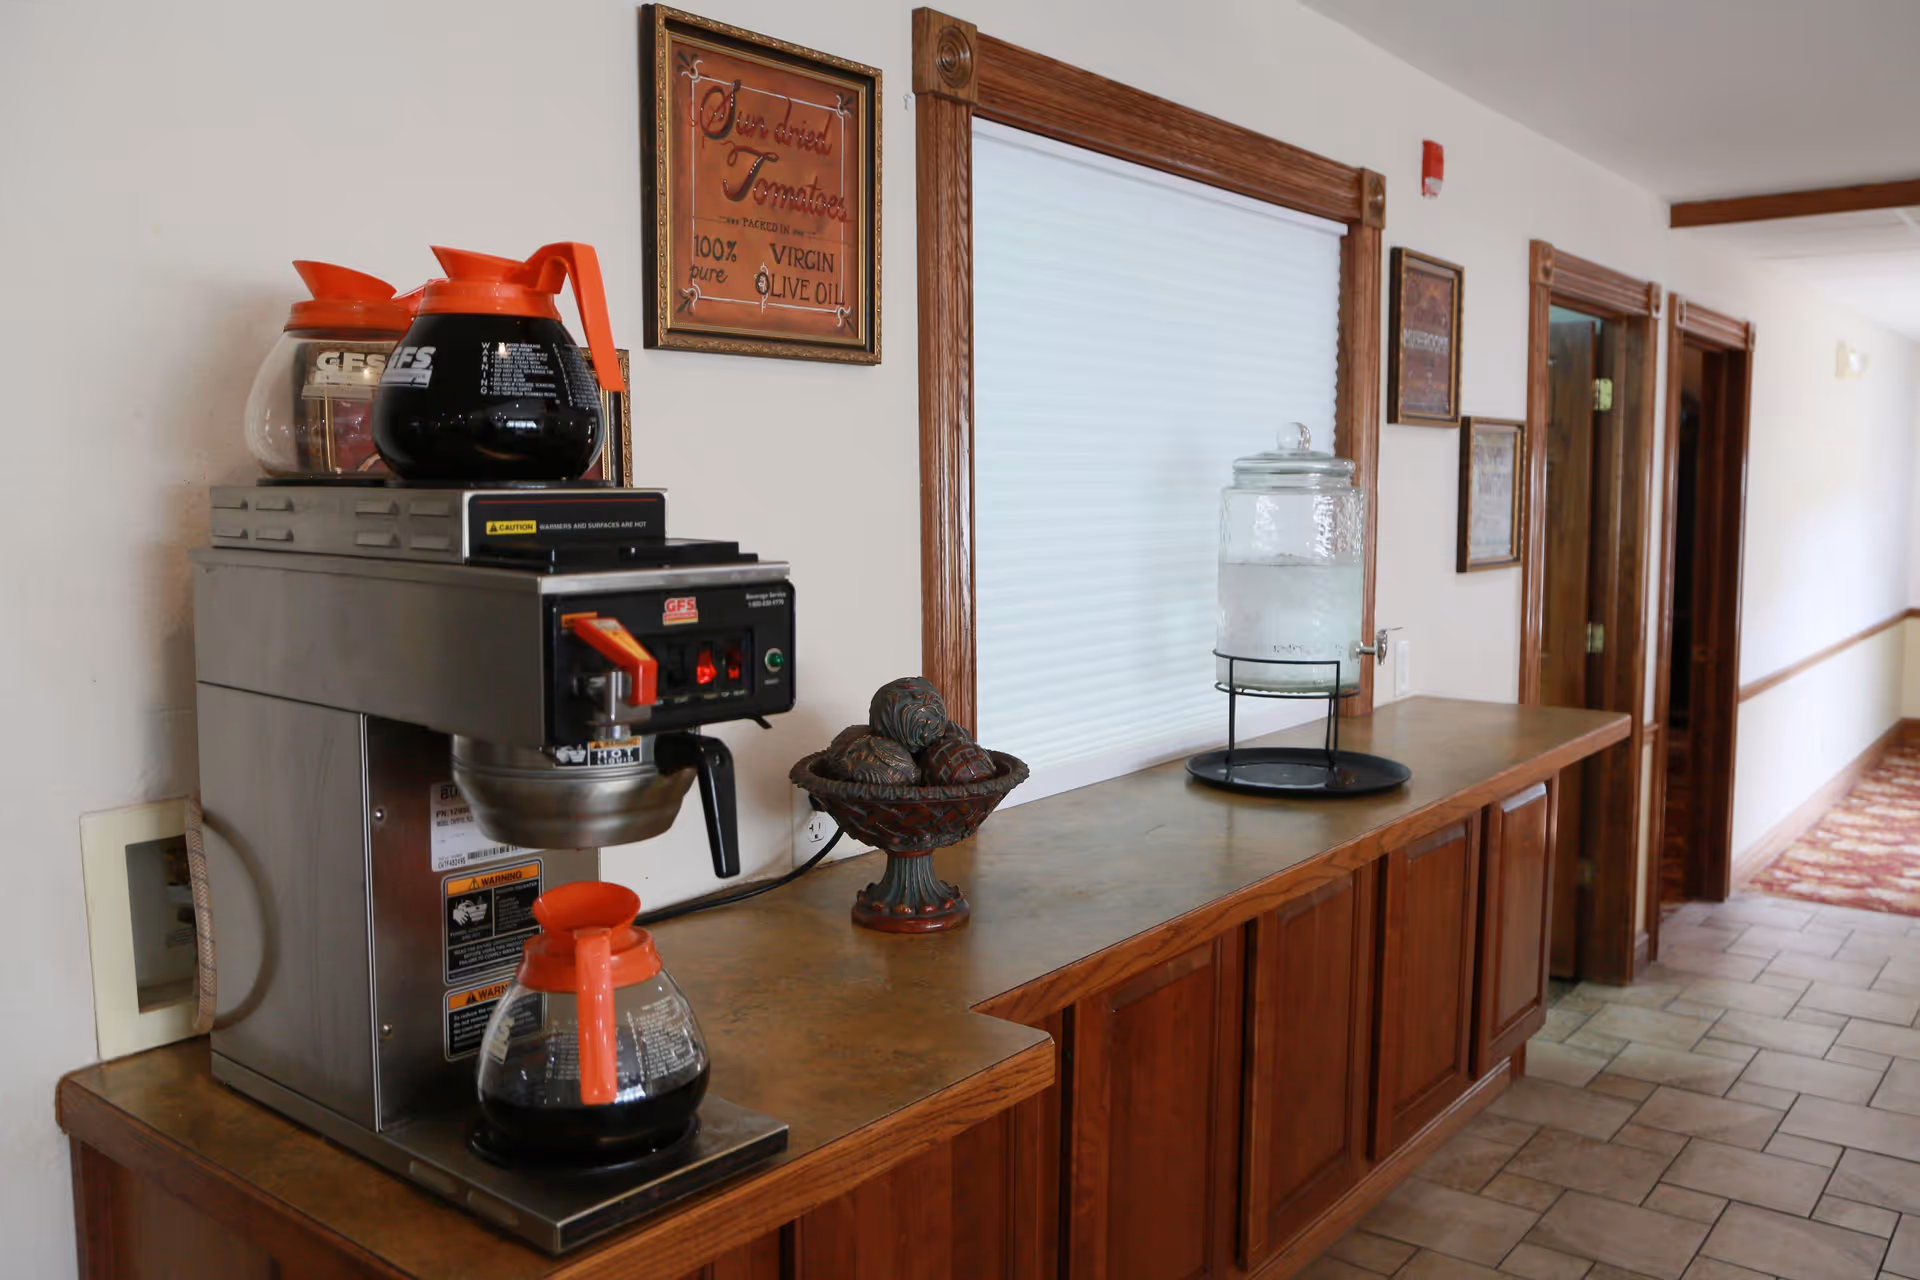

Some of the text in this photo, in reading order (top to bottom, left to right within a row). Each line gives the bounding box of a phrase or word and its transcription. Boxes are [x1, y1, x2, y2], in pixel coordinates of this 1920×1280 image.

[774, 98, 833, 156] dried
[721, 142, 849, 223] Tomatoes
[742, 216, 791, 236] PACKED IN
[694, 234, 737, 262] 100%
[769, 243, 834, 273] VIRGIN
[689, 265, 728, 283] pure
[755, 271, 845, 306] OLIVE OIL
[480, 341, 491, 396] WARNING
[499, 523, 534, 532] CAUTION
[665, 596, 697, 613] GFS
[597, 747, 633, 759] HOT
[597, 756, 634, 765] LIQUID
[480, 870, 522, 886] WARNING
[478, 983, 509, 998] WARN
